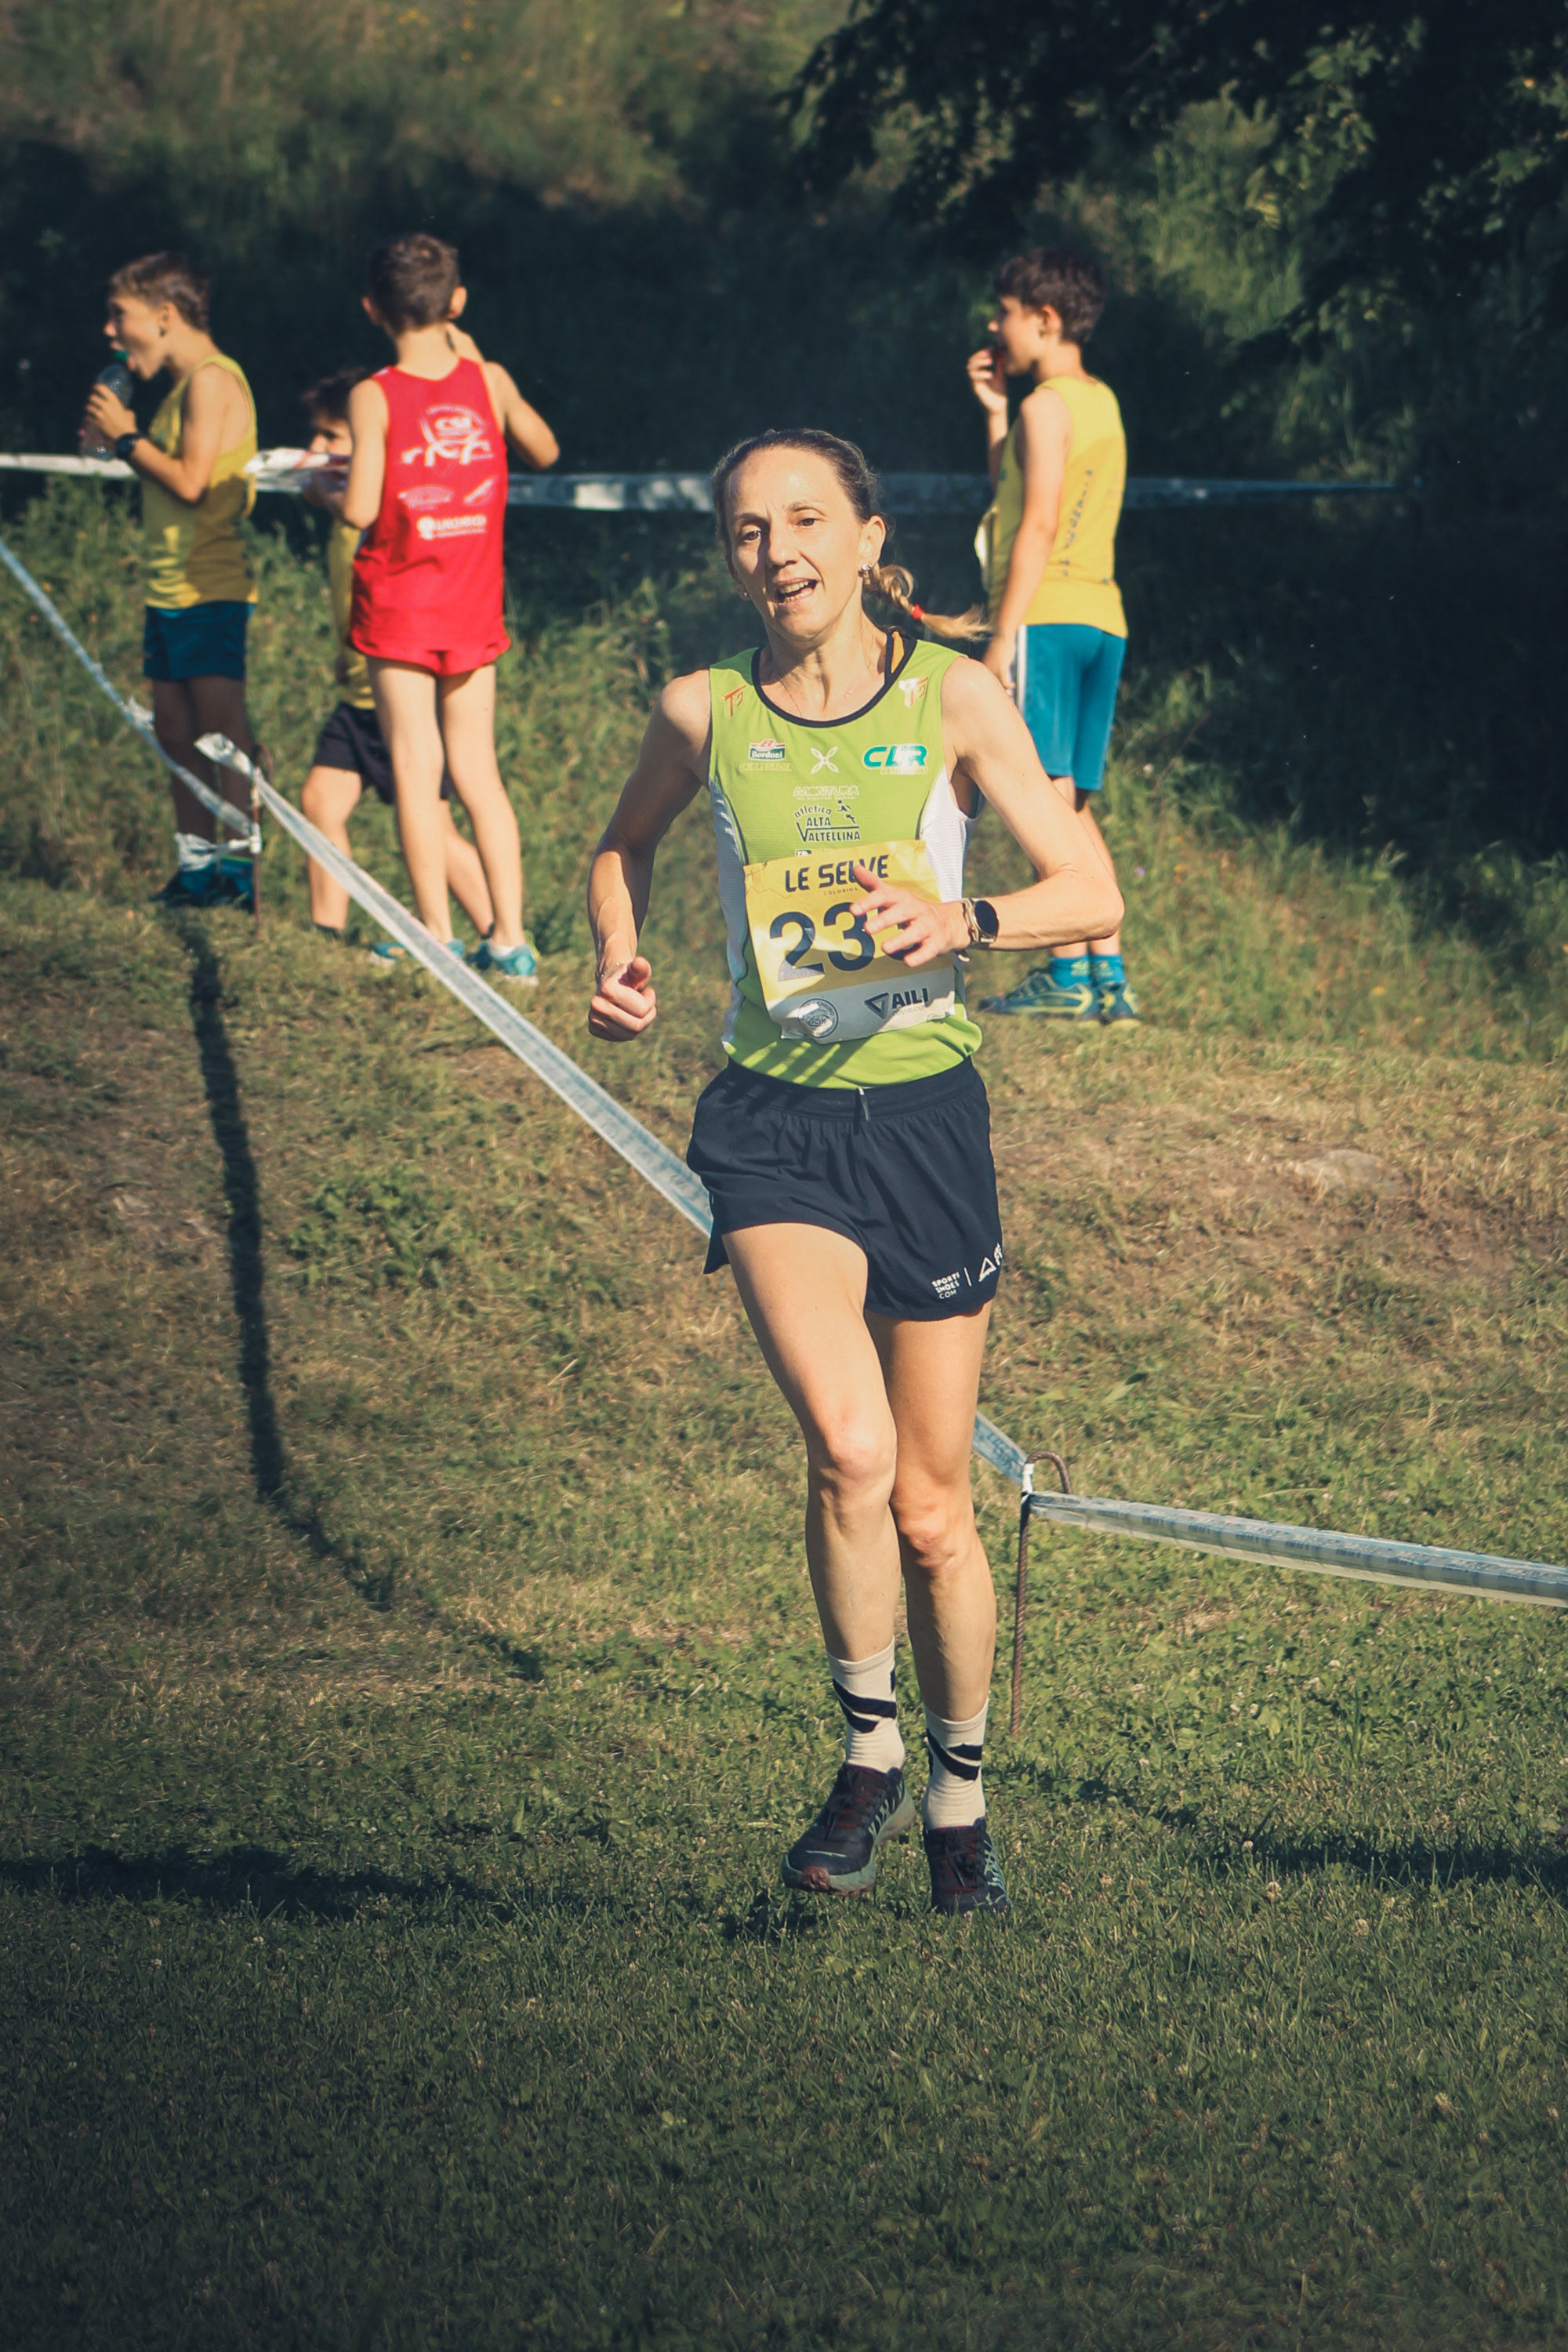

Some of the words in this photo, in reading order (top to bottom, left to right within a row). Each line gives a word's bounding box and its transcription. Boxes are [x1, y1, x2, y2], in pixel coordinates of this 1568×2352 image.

[751, 750, 783, 760] Bordoni
[794, 805, 832, 818] atletica
[807, 817, 831, 826] ALTA
[796, 822, 860, 843] VALTELLINA
[785, 867, 809, 892] LE
[770, 902, 924, 982] 23
[892, 988, 928, 1008] AILI
